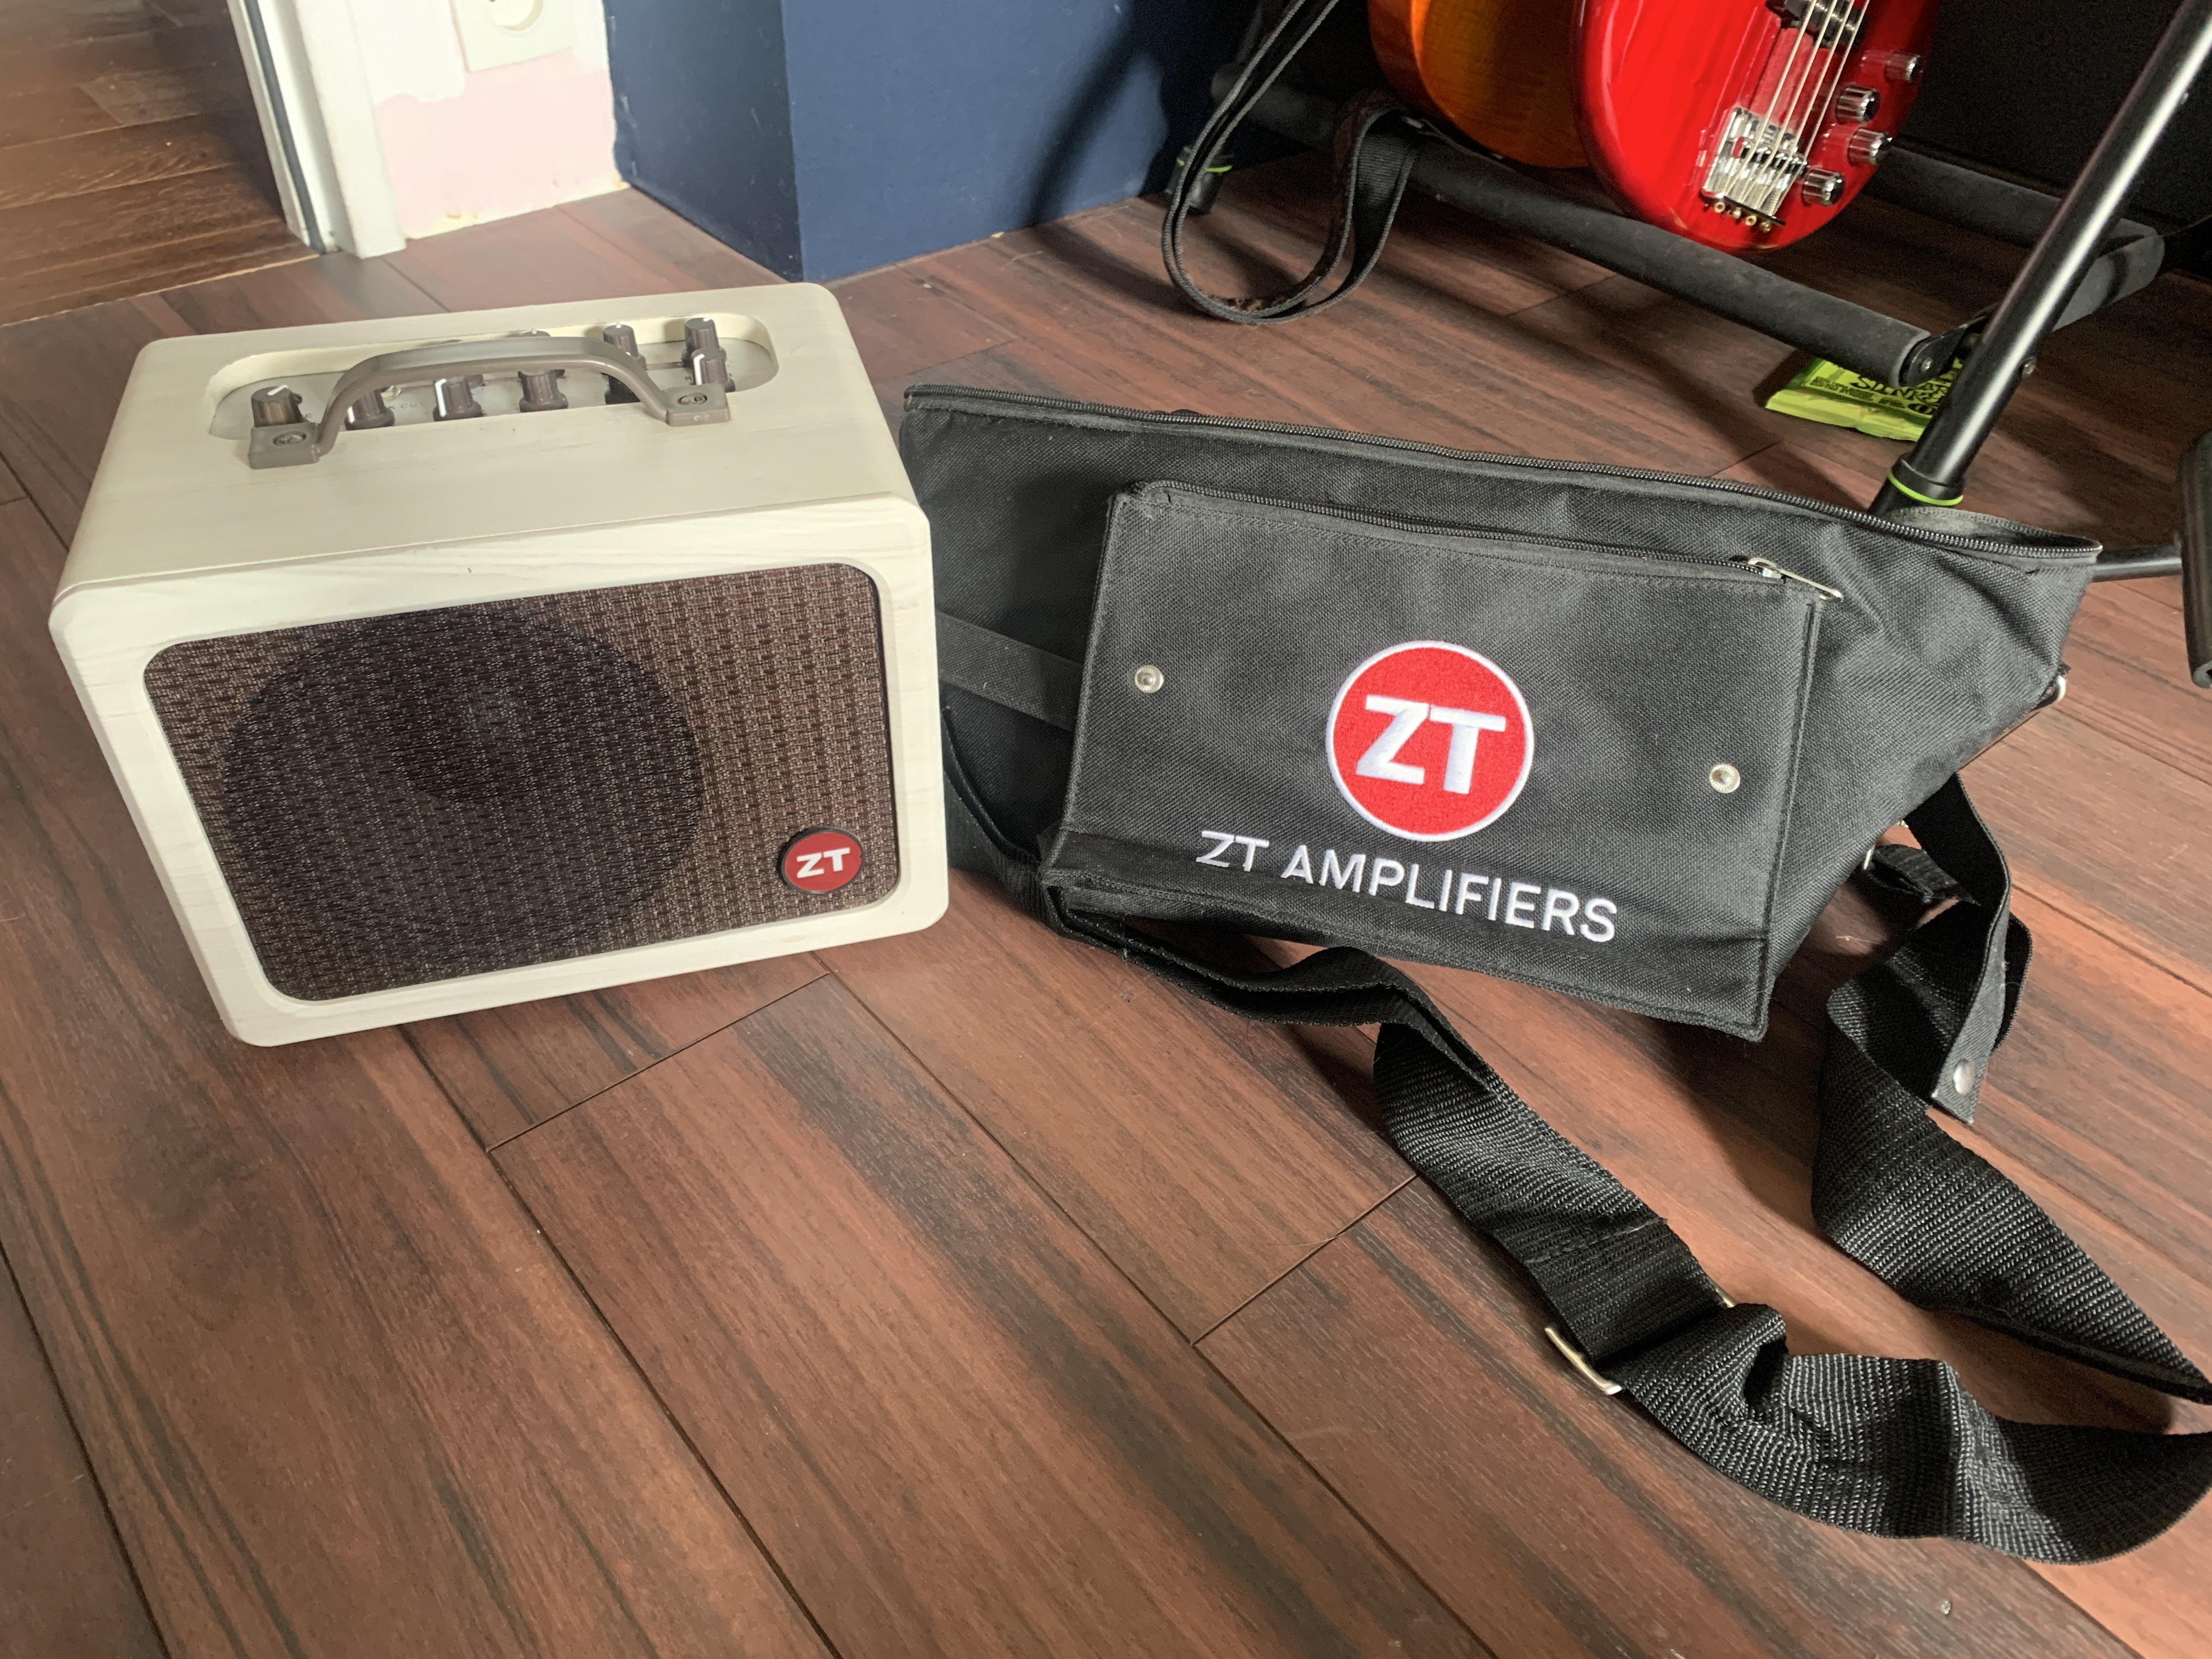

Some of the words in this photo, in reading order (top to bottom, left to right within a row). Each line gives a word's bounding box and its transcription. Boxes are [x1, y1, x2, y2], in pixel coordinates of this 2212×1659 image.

[1355, 694, 1506, 795] ZT
[796, 847, 851, 879] ZT
[1195, 830, 1271, 873] ZT
[1280, 844, 1618, 943] AMPLIFIERS
